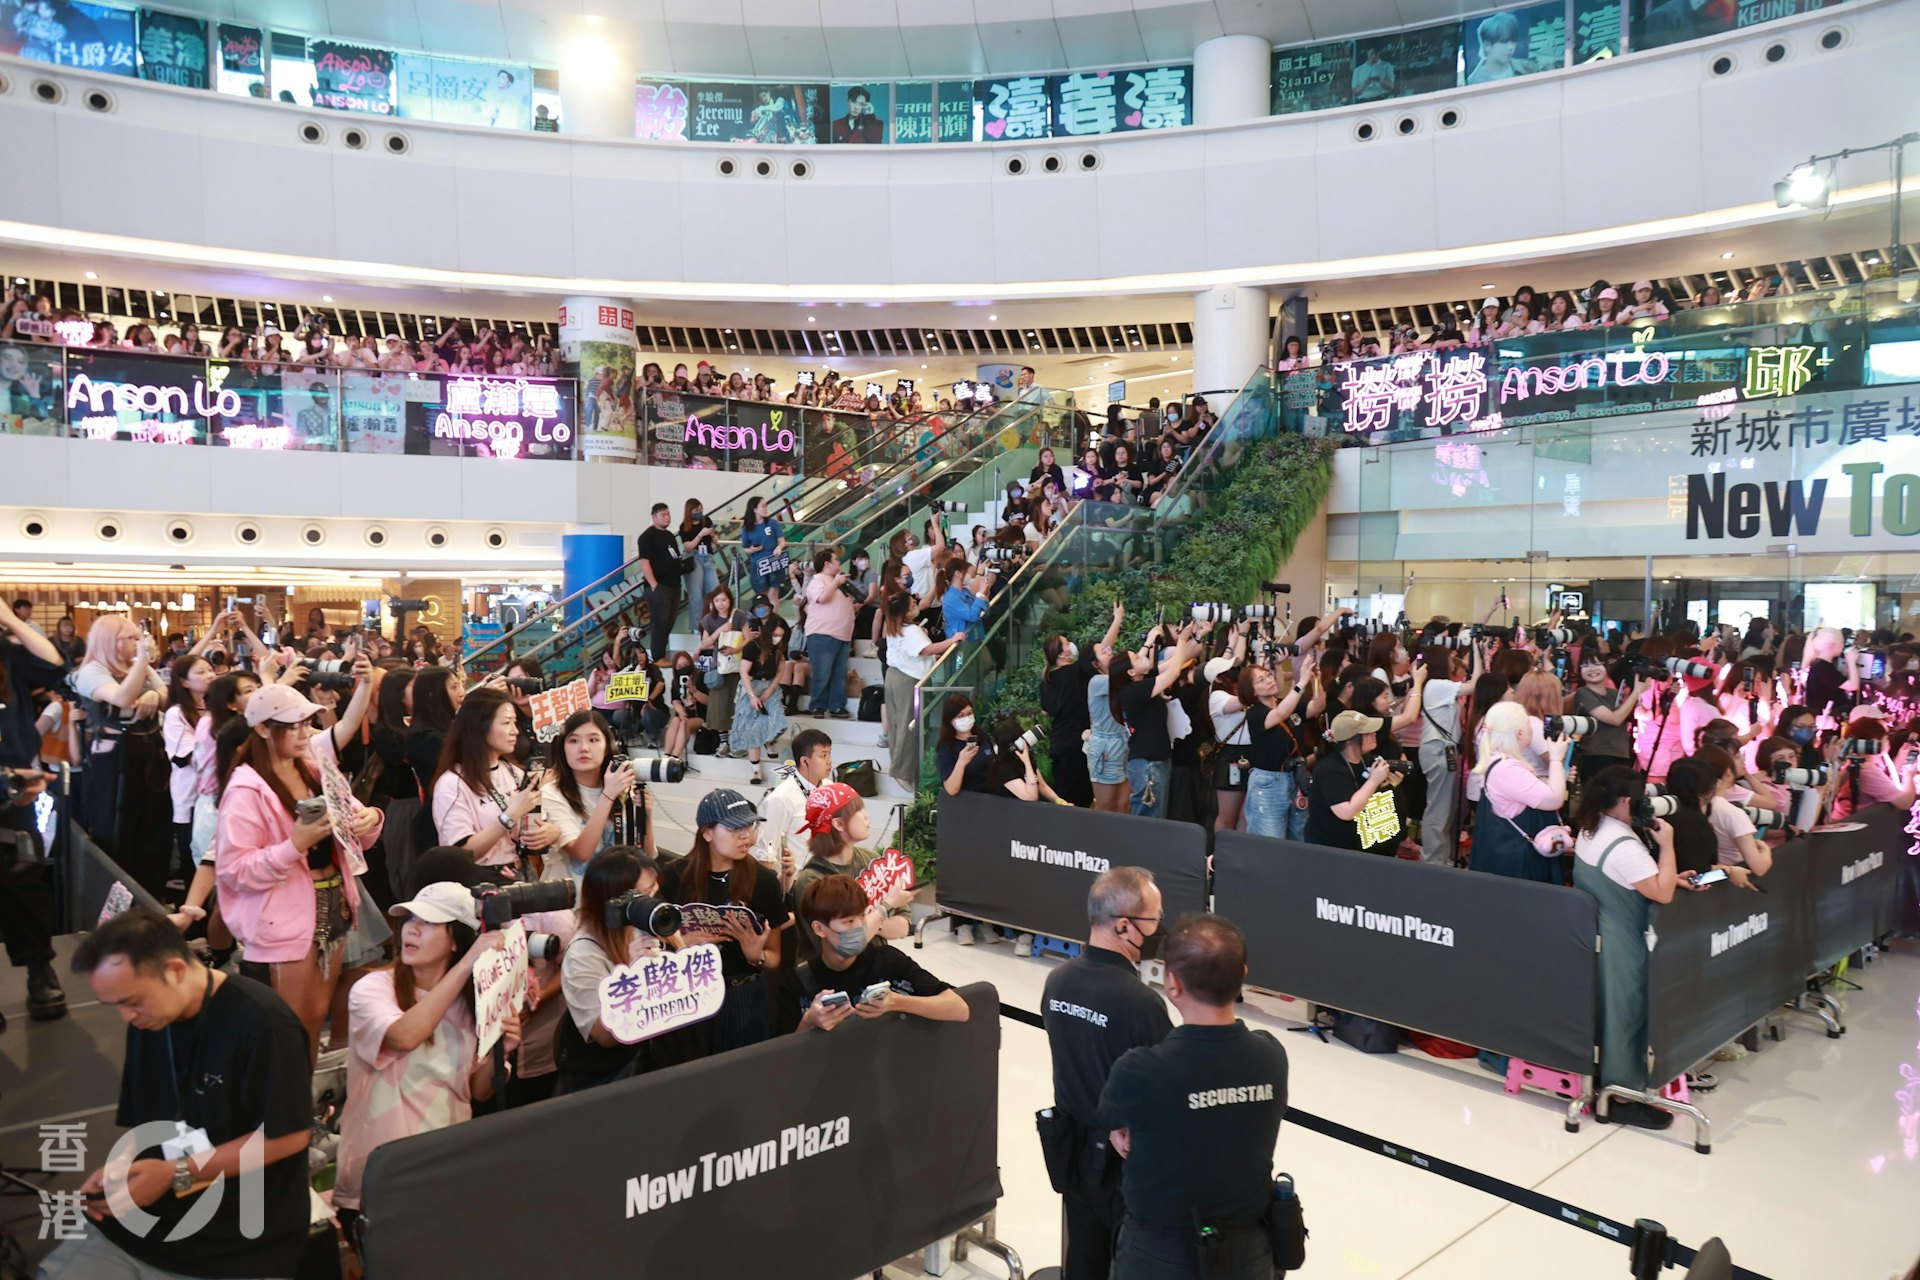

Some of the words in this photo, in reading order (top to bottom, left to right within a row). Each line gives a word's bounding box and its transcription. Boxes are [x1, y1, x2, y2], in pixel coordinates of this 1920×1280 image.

[55, 40, 134, 68] 呂爵安
[140, 26, 206, 71] 姜濤
[407, 71, 491, 102] 呂爵安
[1279, 71, 1336, 89] Stanley
[1279, 90, 1305, 101] Yau
[315, 94, 368, 111] ANSON
[697, 104, 744, 124] Jeremy
[696, 122, 721, 137] Lee
[68, 373, 189, 416] Anson
[193, 380, 242, 418] Lo
[1500, 356, 1607, 404] Anson
[435, 412, 524, 442] Anson
[534, 417, 571, 443] Lo
[685, 413, 758, 451] Anson
[761, 422, 794, 452] Lo
[1685, 472, 1829, 541] New
[530, 680, 591, 730] 王智德
[609, 685, 645, 699] STANLEY
[1010, 839, 1040, 863] New
[1039, 844, 1074, 868] Town
[1074, 850, 1110, 874] Plaza
[1316, 896, 1356, 926] New
[1355, 905, 1404, 937] Town
[1404, 914, 1455, 948] Plaza
[1711, 931, 1729, 958] New
[1728, 923, 1749, 948] Town
[1748, 911, 1769, 938] Plaza
[607, 948, 720, 1015] 李駿傑
[636, 992, 701, 1030] JEREMY
[1049, 998, 1109, 1028] SECURSTAR
[1187, 1083, 1275, 1110] SECURSTAR
[625, 1164, 698, 1220] New
[699, 1151, 778, 1194] Town
[779, 1115, 851, 1167] Plaza
